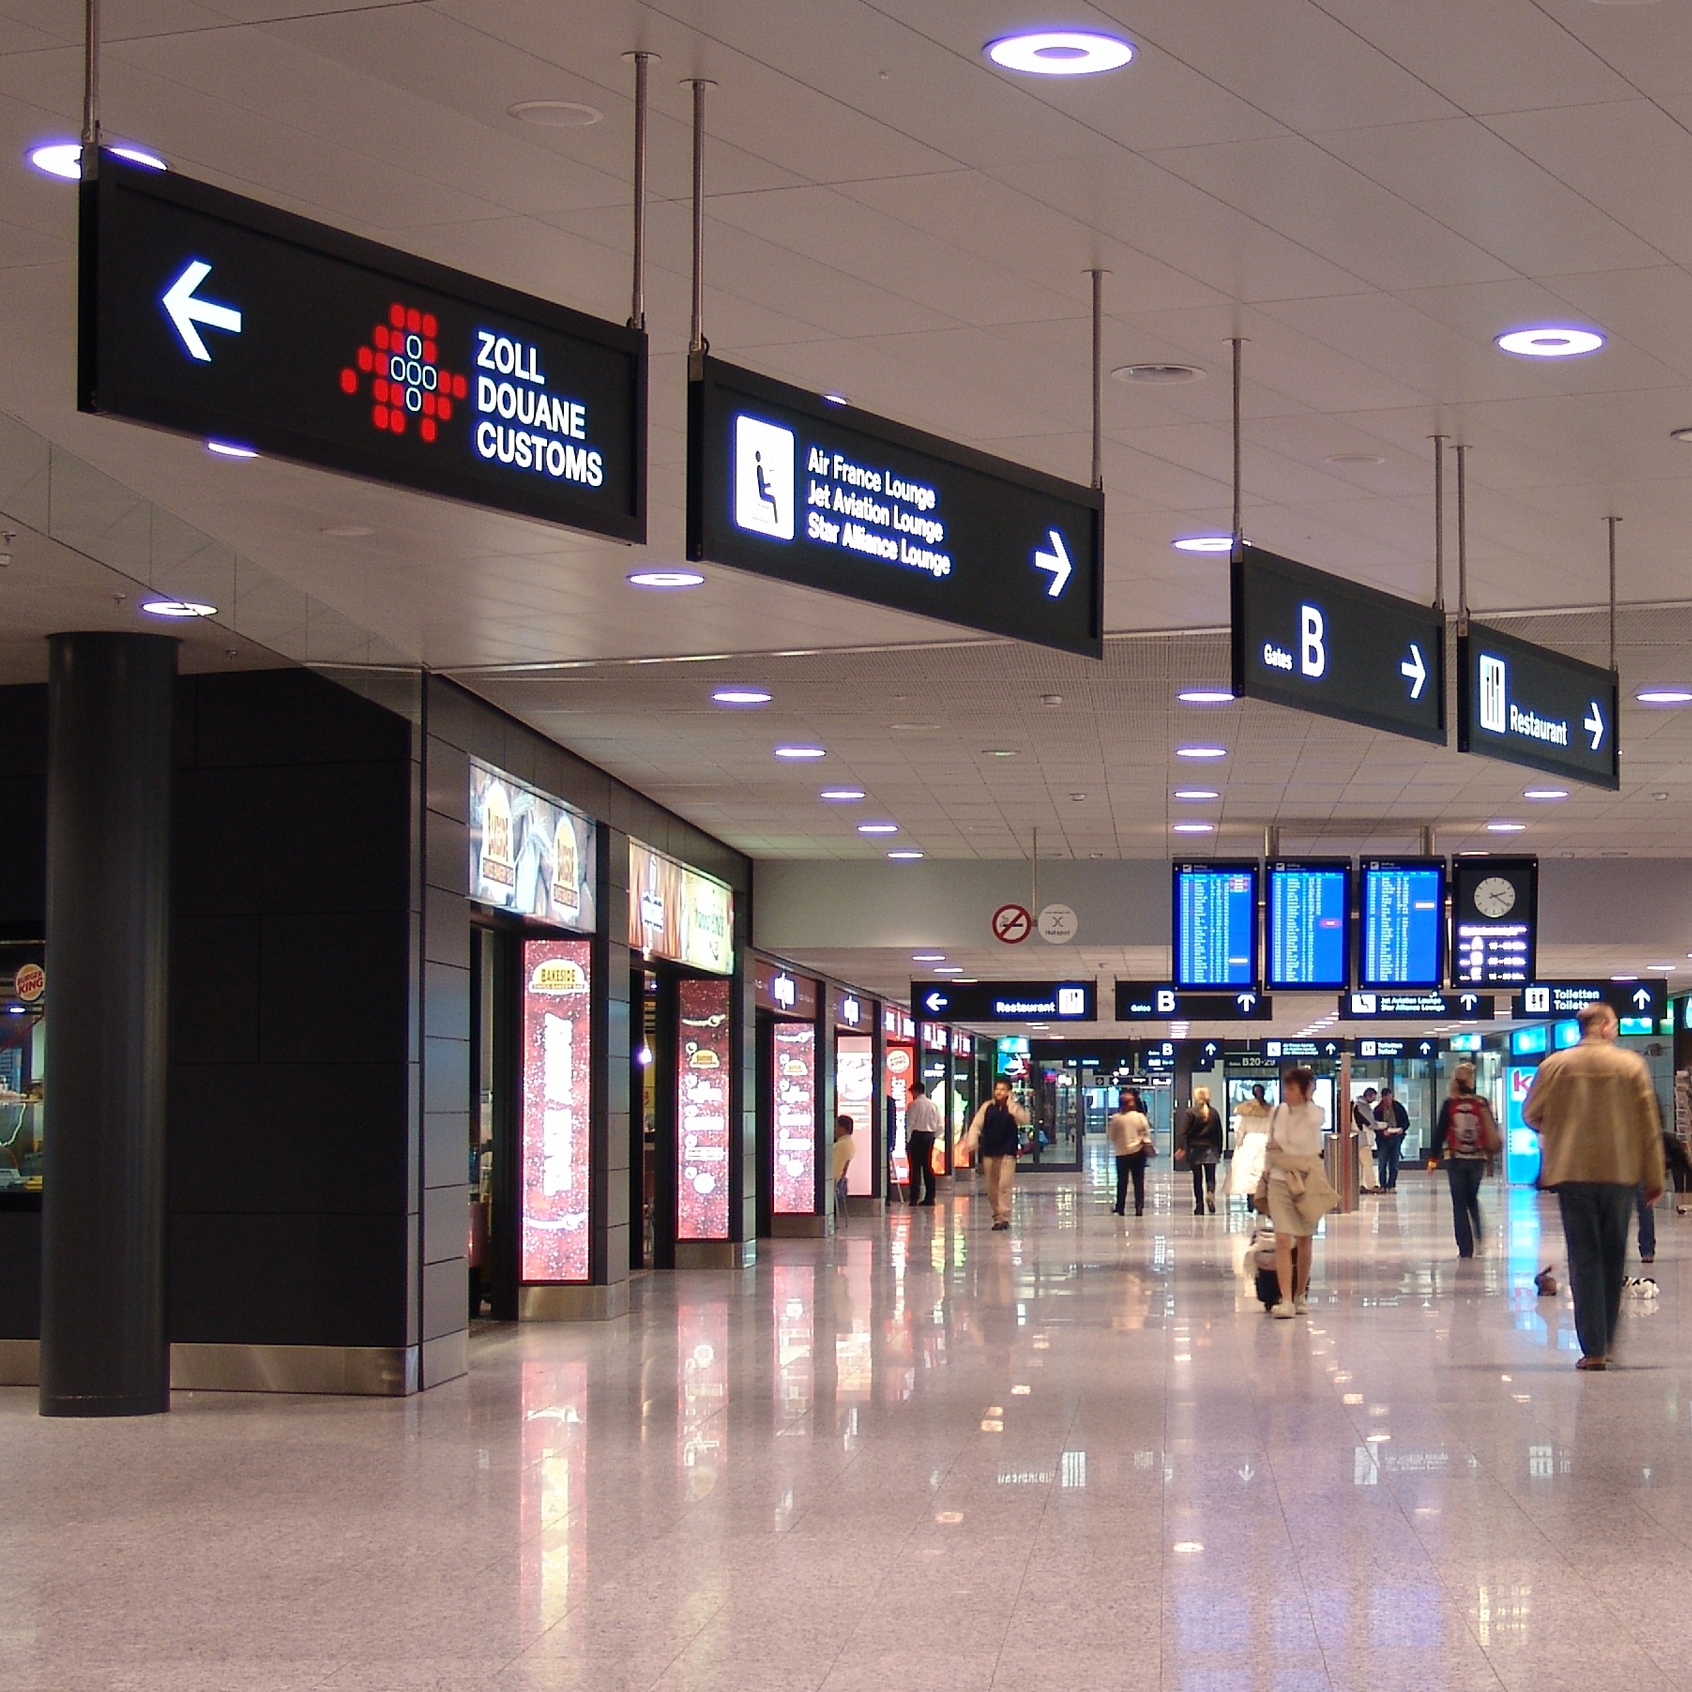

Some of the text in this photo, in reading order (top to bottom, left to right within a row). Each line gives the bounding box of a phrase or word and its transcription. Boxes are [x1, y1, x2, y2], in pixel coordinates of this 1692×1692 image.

[477, 330, 545, 385] ZOLL
[477, 376, 586, 440] DOUANE
[477, 421, 603, 487] CUSTOMS
[807, 447, 936, 511] Air France Lounge
[807, 480, 944, 543] Jet Aviation Lounge
[808, 512, 951, 577] Star Alliance Lounge
[1263, 643, 1293, 671] Gates
[1301, 605, 1326, 678] B
[1510, 704, 1568, 747] Restaurant
[18, 977, 43, 995] KING
[541, 969, 575, 982] BAKESIDE
[1553, 988, 1600, 999] Toiletten
[996, 1002, 1056, 1013] Restaurant
[1157, 990, 1176, 1012] B
[1162, 1043, 1173, 1056] B
